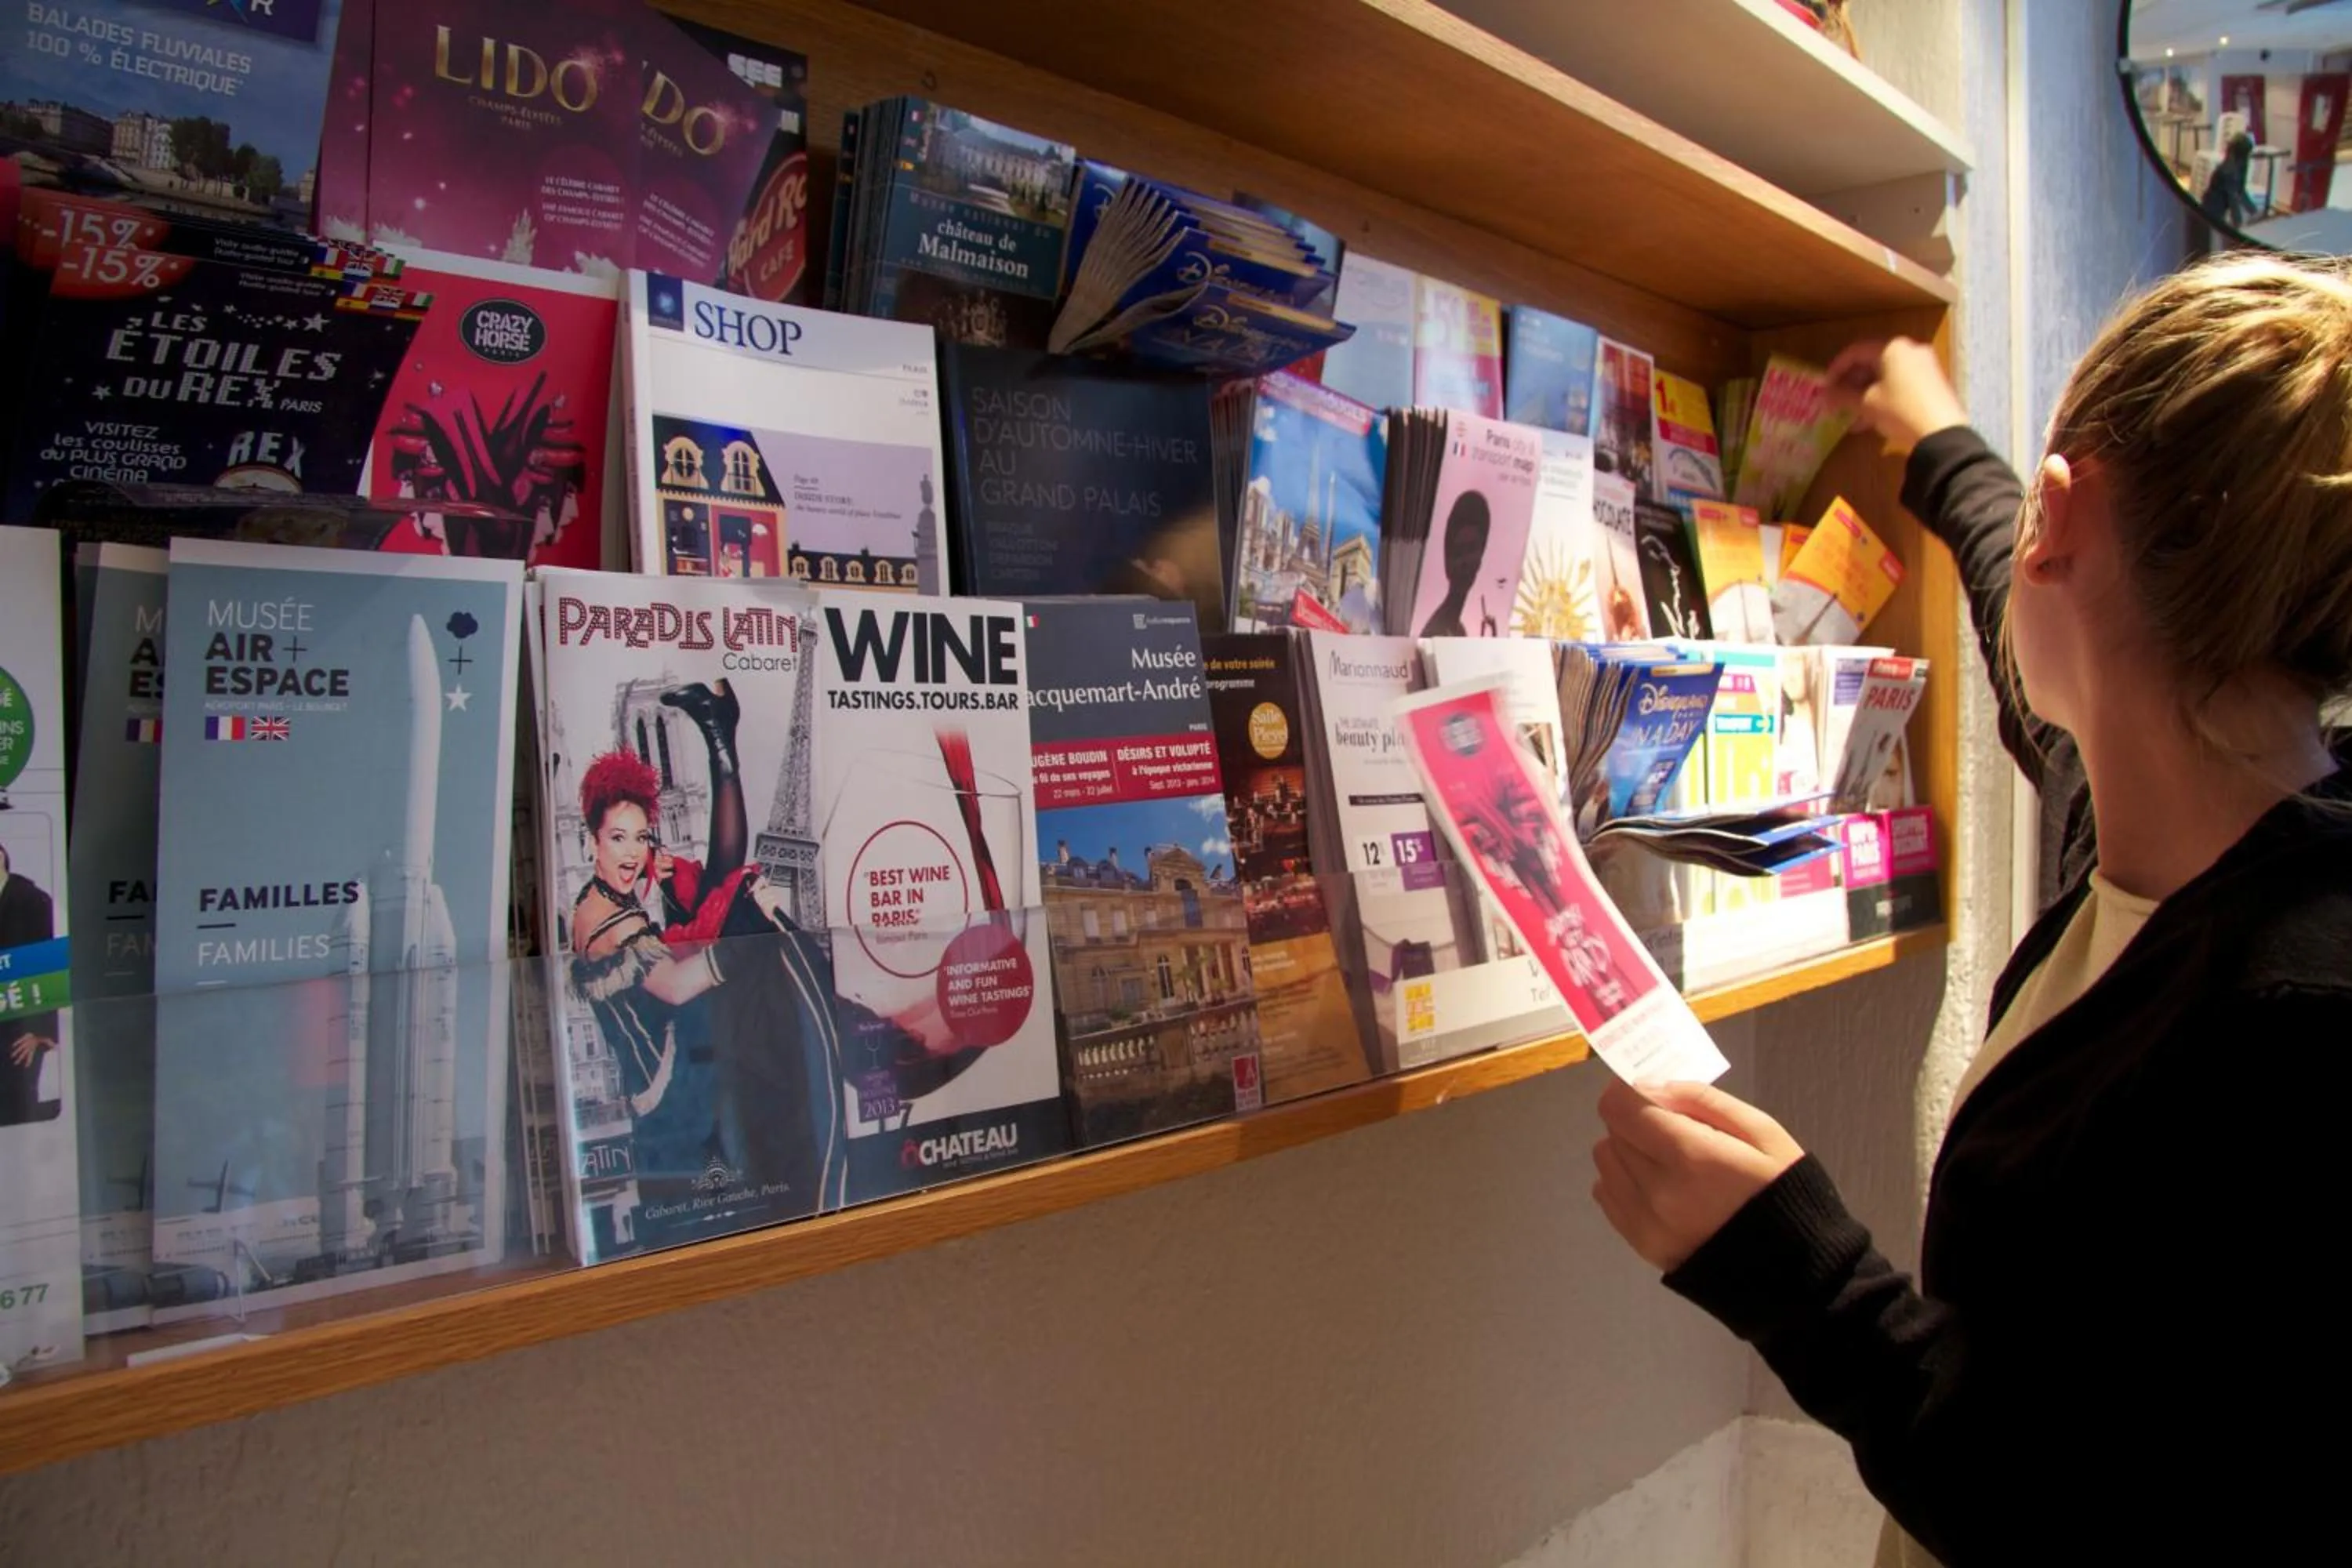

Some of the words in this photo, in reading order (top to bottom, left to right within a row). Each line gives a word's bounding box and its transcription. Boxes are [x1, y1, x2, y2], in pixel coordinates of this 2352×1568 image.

[27, 2, 135, 46] BALADES
[141, 31, 252, 74] FLUVIALES
[27, 30, 71, 58] 100
[78, 42, 102, 66] %
[435, 24, 598, 114] LIDO
[641, 61, 726, 156] DO
[937, 218, 993, 246] château
[999, 233, 1017, 252] de
[917, 232, 1029, 279] Malmaison
[151, 311, 208, 332] LES
[477, 310, 533, 333] CRAZY
[695, 300, 803, 357] SHOP
[106, 318, 342, 382] ÉTOILES
[474, 327, 531, 351] HORSE
[123, 377, 170, 399] DU
[176, 372, 281, 410] REX
[280, 398, 323, 414] PARIS
[971, 387, 1073, 423] SAISON
[85, 421, 160, 440] VISITEZ
[91, 436, 182, 456] coulisses
[973, 418, 1199, 465] D'AUTOMNE-HIVER
[70, 449, 118, 466] PLUS
[227, 432, 306, 477] REX
[978, 449, 1017, 476] AU
[981, 479, 1076, 512] GRAND
[1083, 486, 1162, 517] PALAIS
[207, 597, 315, 631] MUSÉE
[559, 596, 714, 651] PARADIS
[722, 604, 798, 654] LATIN
[205, 632, 274, 663] AIR
[824, 607, 1017, 685] WINE
[1131, 643, 1196, 670] Musée
[722, 652, 798, 673] Cabaret
[205, 666, 350, 698] ESPACE
[1025, 675, 1202, 710] acquemart-André
[1864, 684, 1915, 711] PARIS
[828, 688, 1018, 711] TASTINGS.TOURS.BAR
[1116, 745, 1153, 761] DÉSIRS
[1155, 745, 1167, 759] ET
[1170, 740, 1211, 757] VOLUPTÉ
[1334, 721, 1378, 753] beauty
[909, 865, 949, 884] WINE
[199, 880, 358, 912] FAMILLES
[870, 890, 902, 907] BAR
[907, 887, 924, 903] IN
[197, 931, 331, 967] FAMILIES
[948, 978, 972, 991] AND
[975, 976, 997, 988] FUN
[948, 993, 978, 1007] WINE
